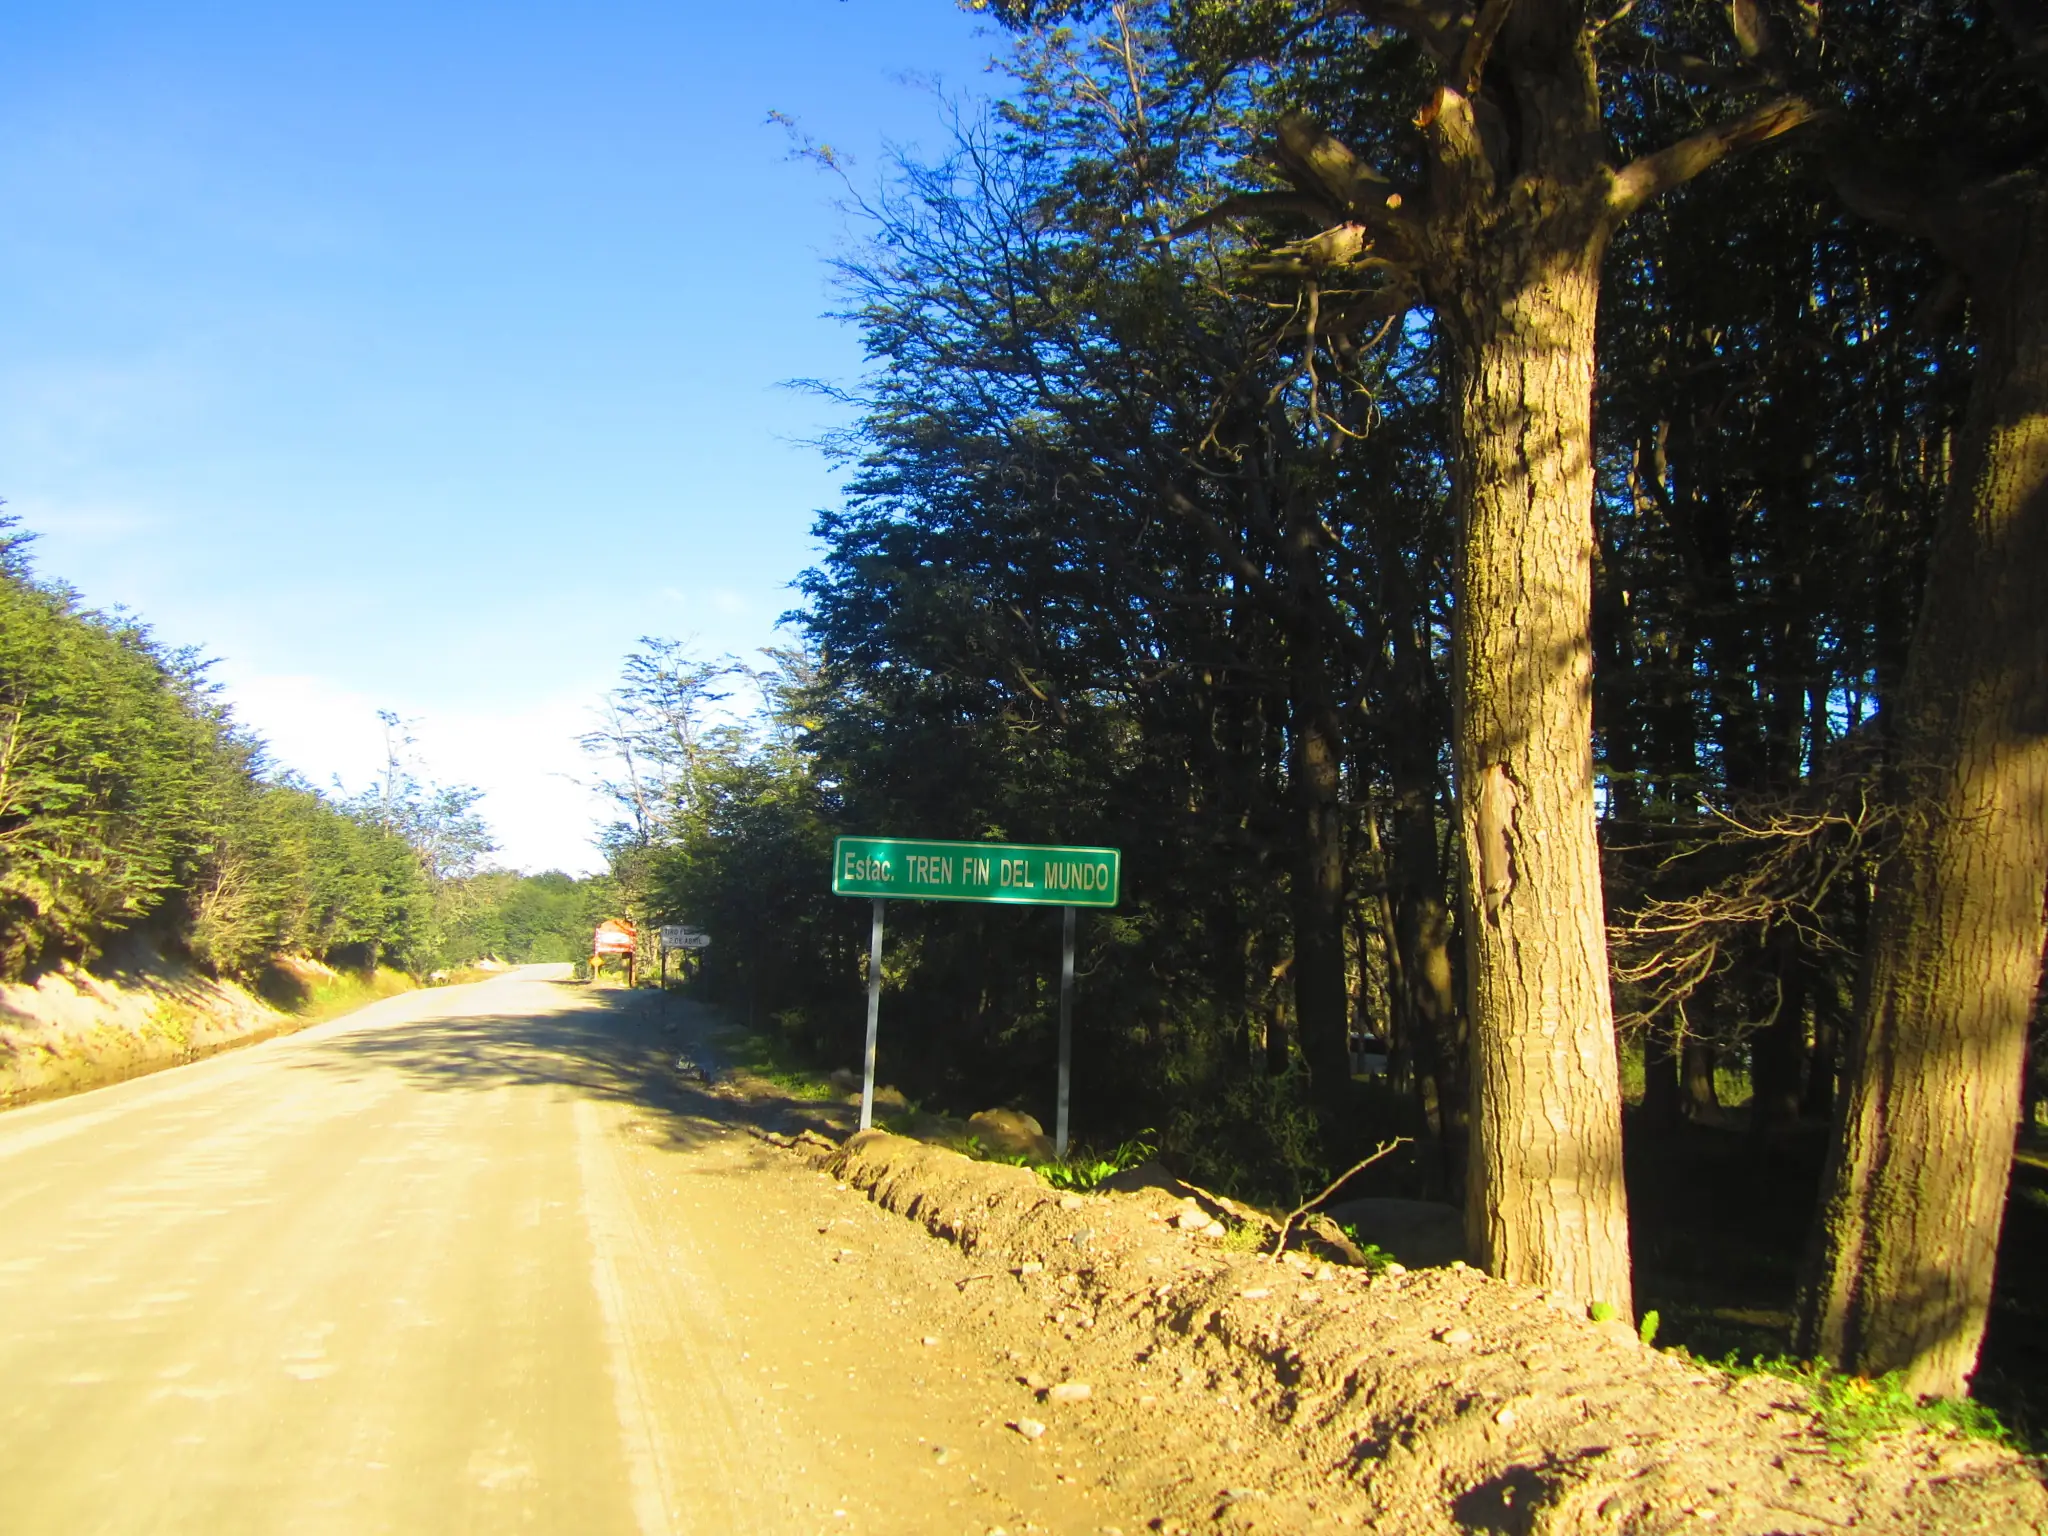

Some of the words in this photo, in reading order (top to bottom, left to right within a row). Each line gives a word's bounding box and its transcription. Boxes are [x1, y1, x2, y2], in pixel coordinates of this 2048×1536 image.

[844, 852, 894, 881] Estac.
[906, 855, 952, 884] TREN
[962, 857, 990, 885] FIN
[1000, 859, 1034, 888] DEL
[1044, 861, 1109, 890] MUNDO
